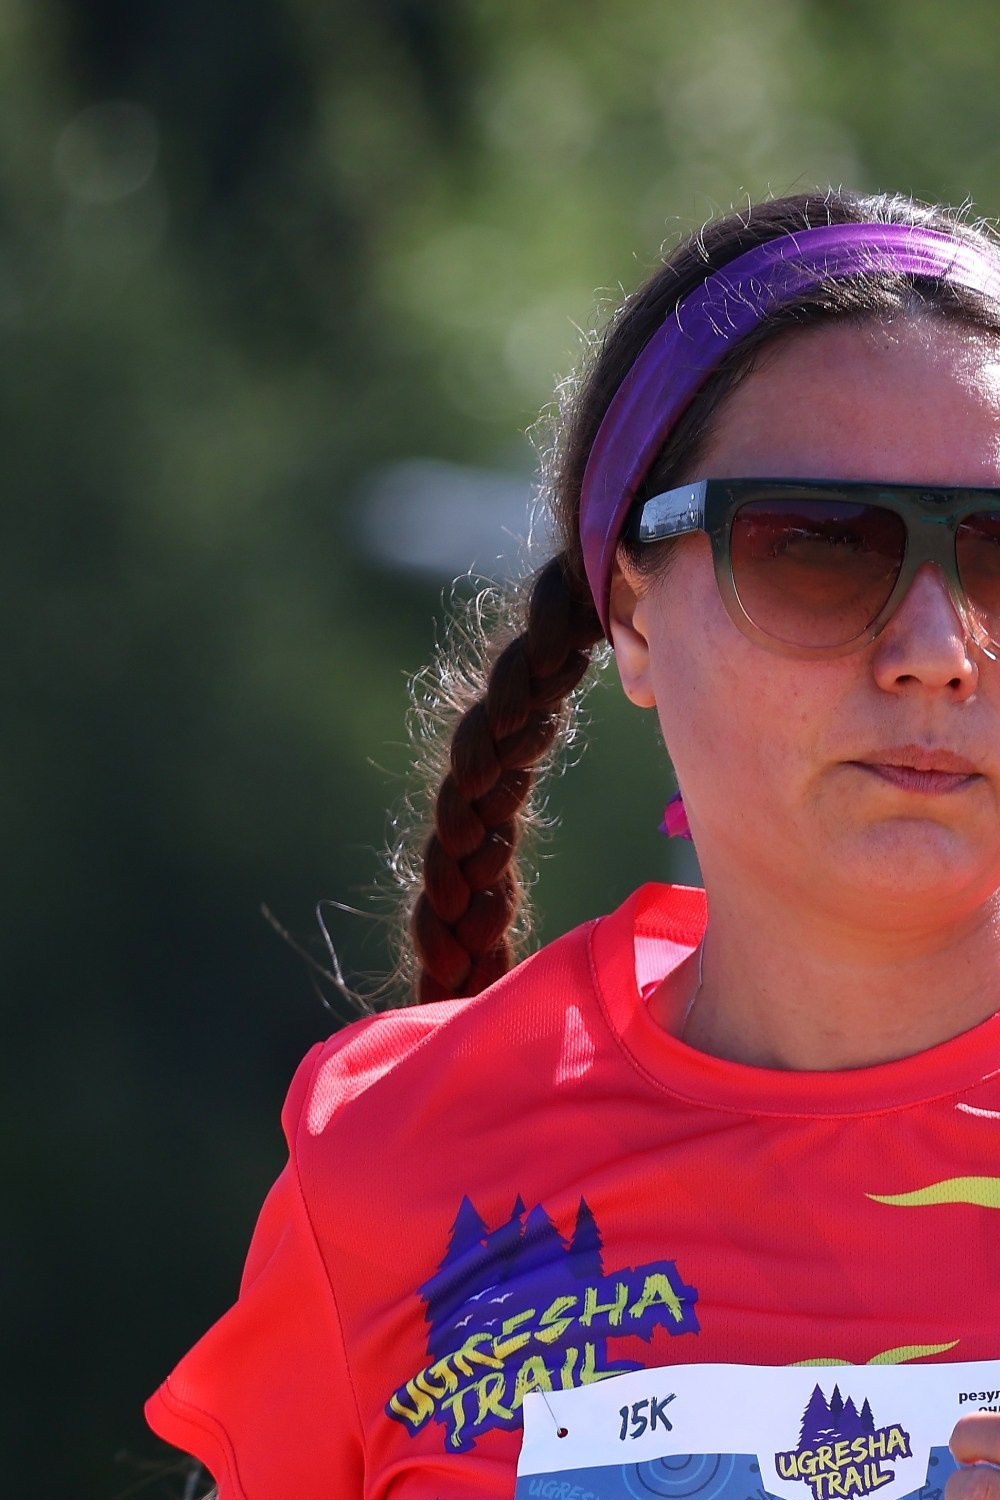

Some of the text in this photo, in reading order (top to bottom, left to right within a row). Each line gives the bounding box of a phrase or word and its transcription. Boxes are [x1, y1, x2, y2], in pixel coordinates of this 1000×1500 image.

[441, 1341, 634, 1448] TRAIL
[619, 1393, 677, 1441] 15K
[778, 1428, 907, 1478] UGRESHA
[808, 1463, 891, 1500] TRAIL
